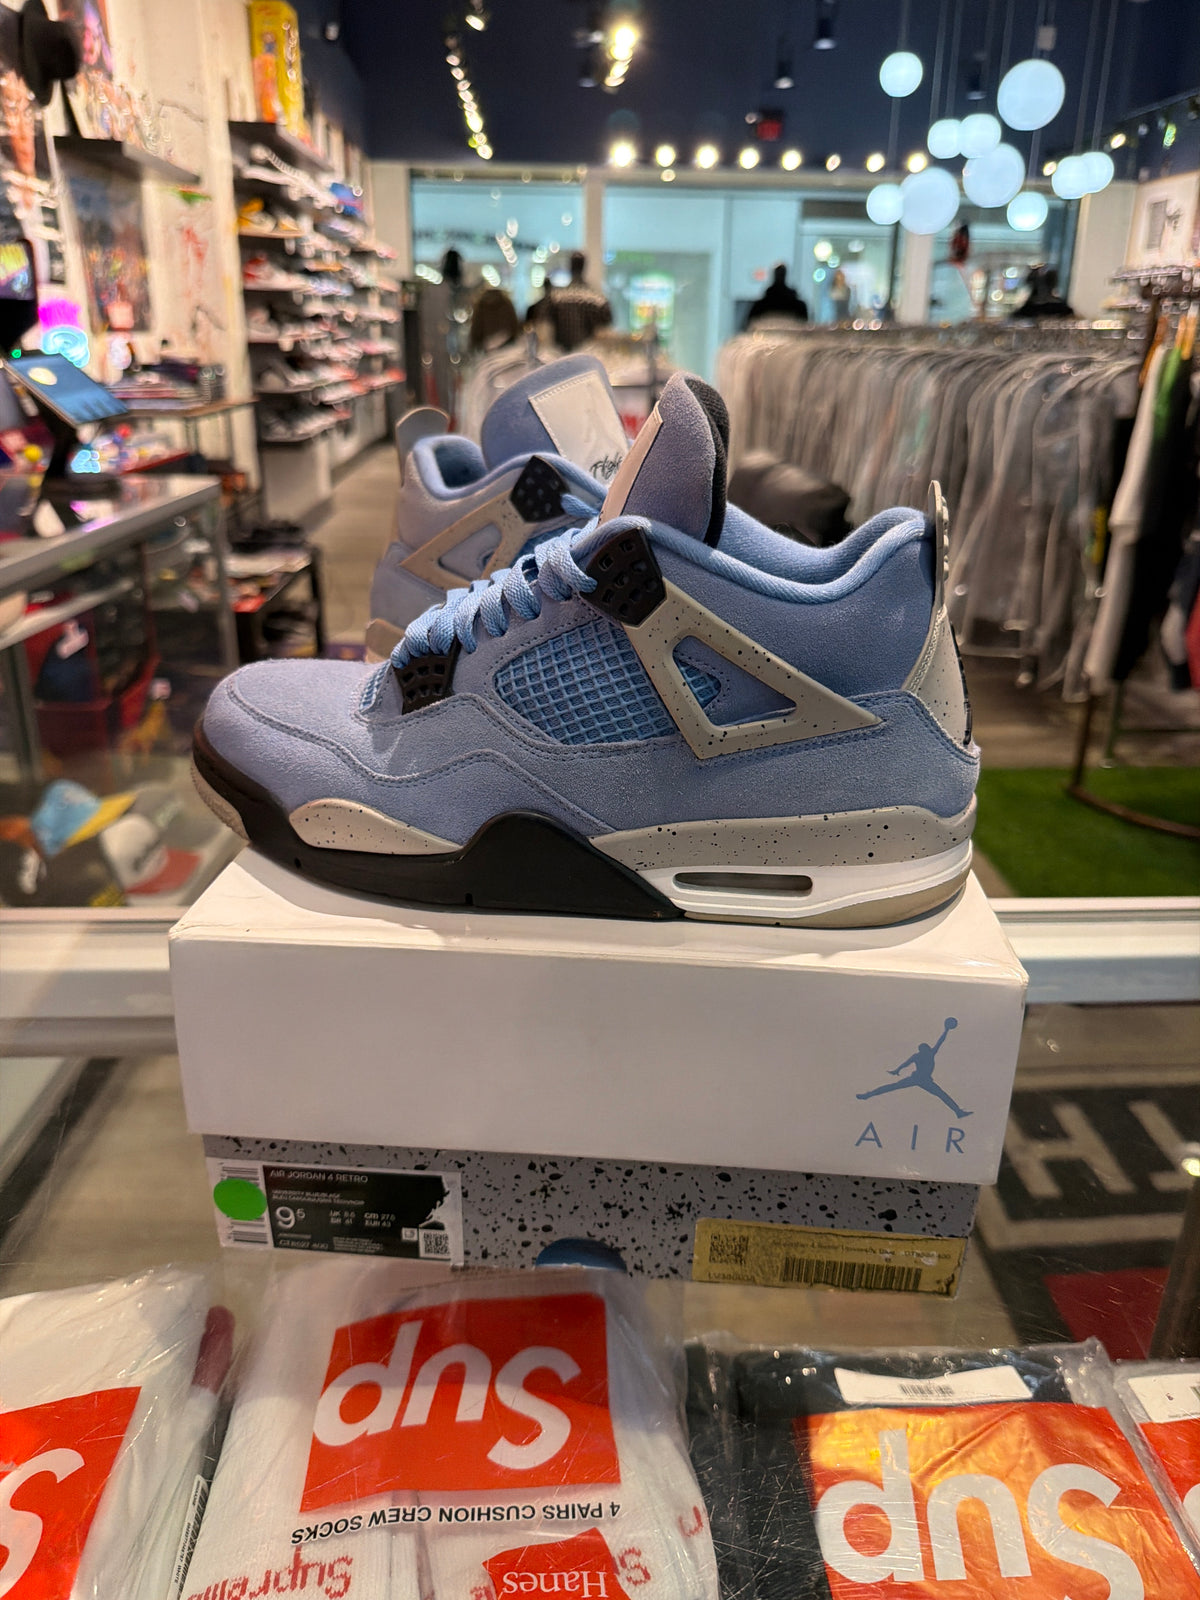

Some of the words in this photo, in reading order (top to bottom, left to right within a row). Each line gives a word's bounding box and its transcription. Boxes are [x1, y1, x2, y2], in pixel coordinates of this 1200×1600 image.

[588, 451, 624, 481] Fligh
[855, 1121, 966, 1154] AIR
[269, 1169, 286, 1178] AIR
[288, 1171, 326, 1181] JORDAN
[327, 1173, 334, 1181] 4
[335, 1174, 369, 1184] RETRO
[313, 1320, 581, 1470] Sup
[367, 1505, 433, 1530] CREW
[438, 1503, 536, 1524] CUSHION
[544, 1502, 604, 1520] PAIRS
[609, 1501, 621, 1518] 4
[816, 1429, 1145, 1600] Sup
[291, 1514, 361, 1546] SOCKS
[503, 1570, 608, 1599] Hanes
